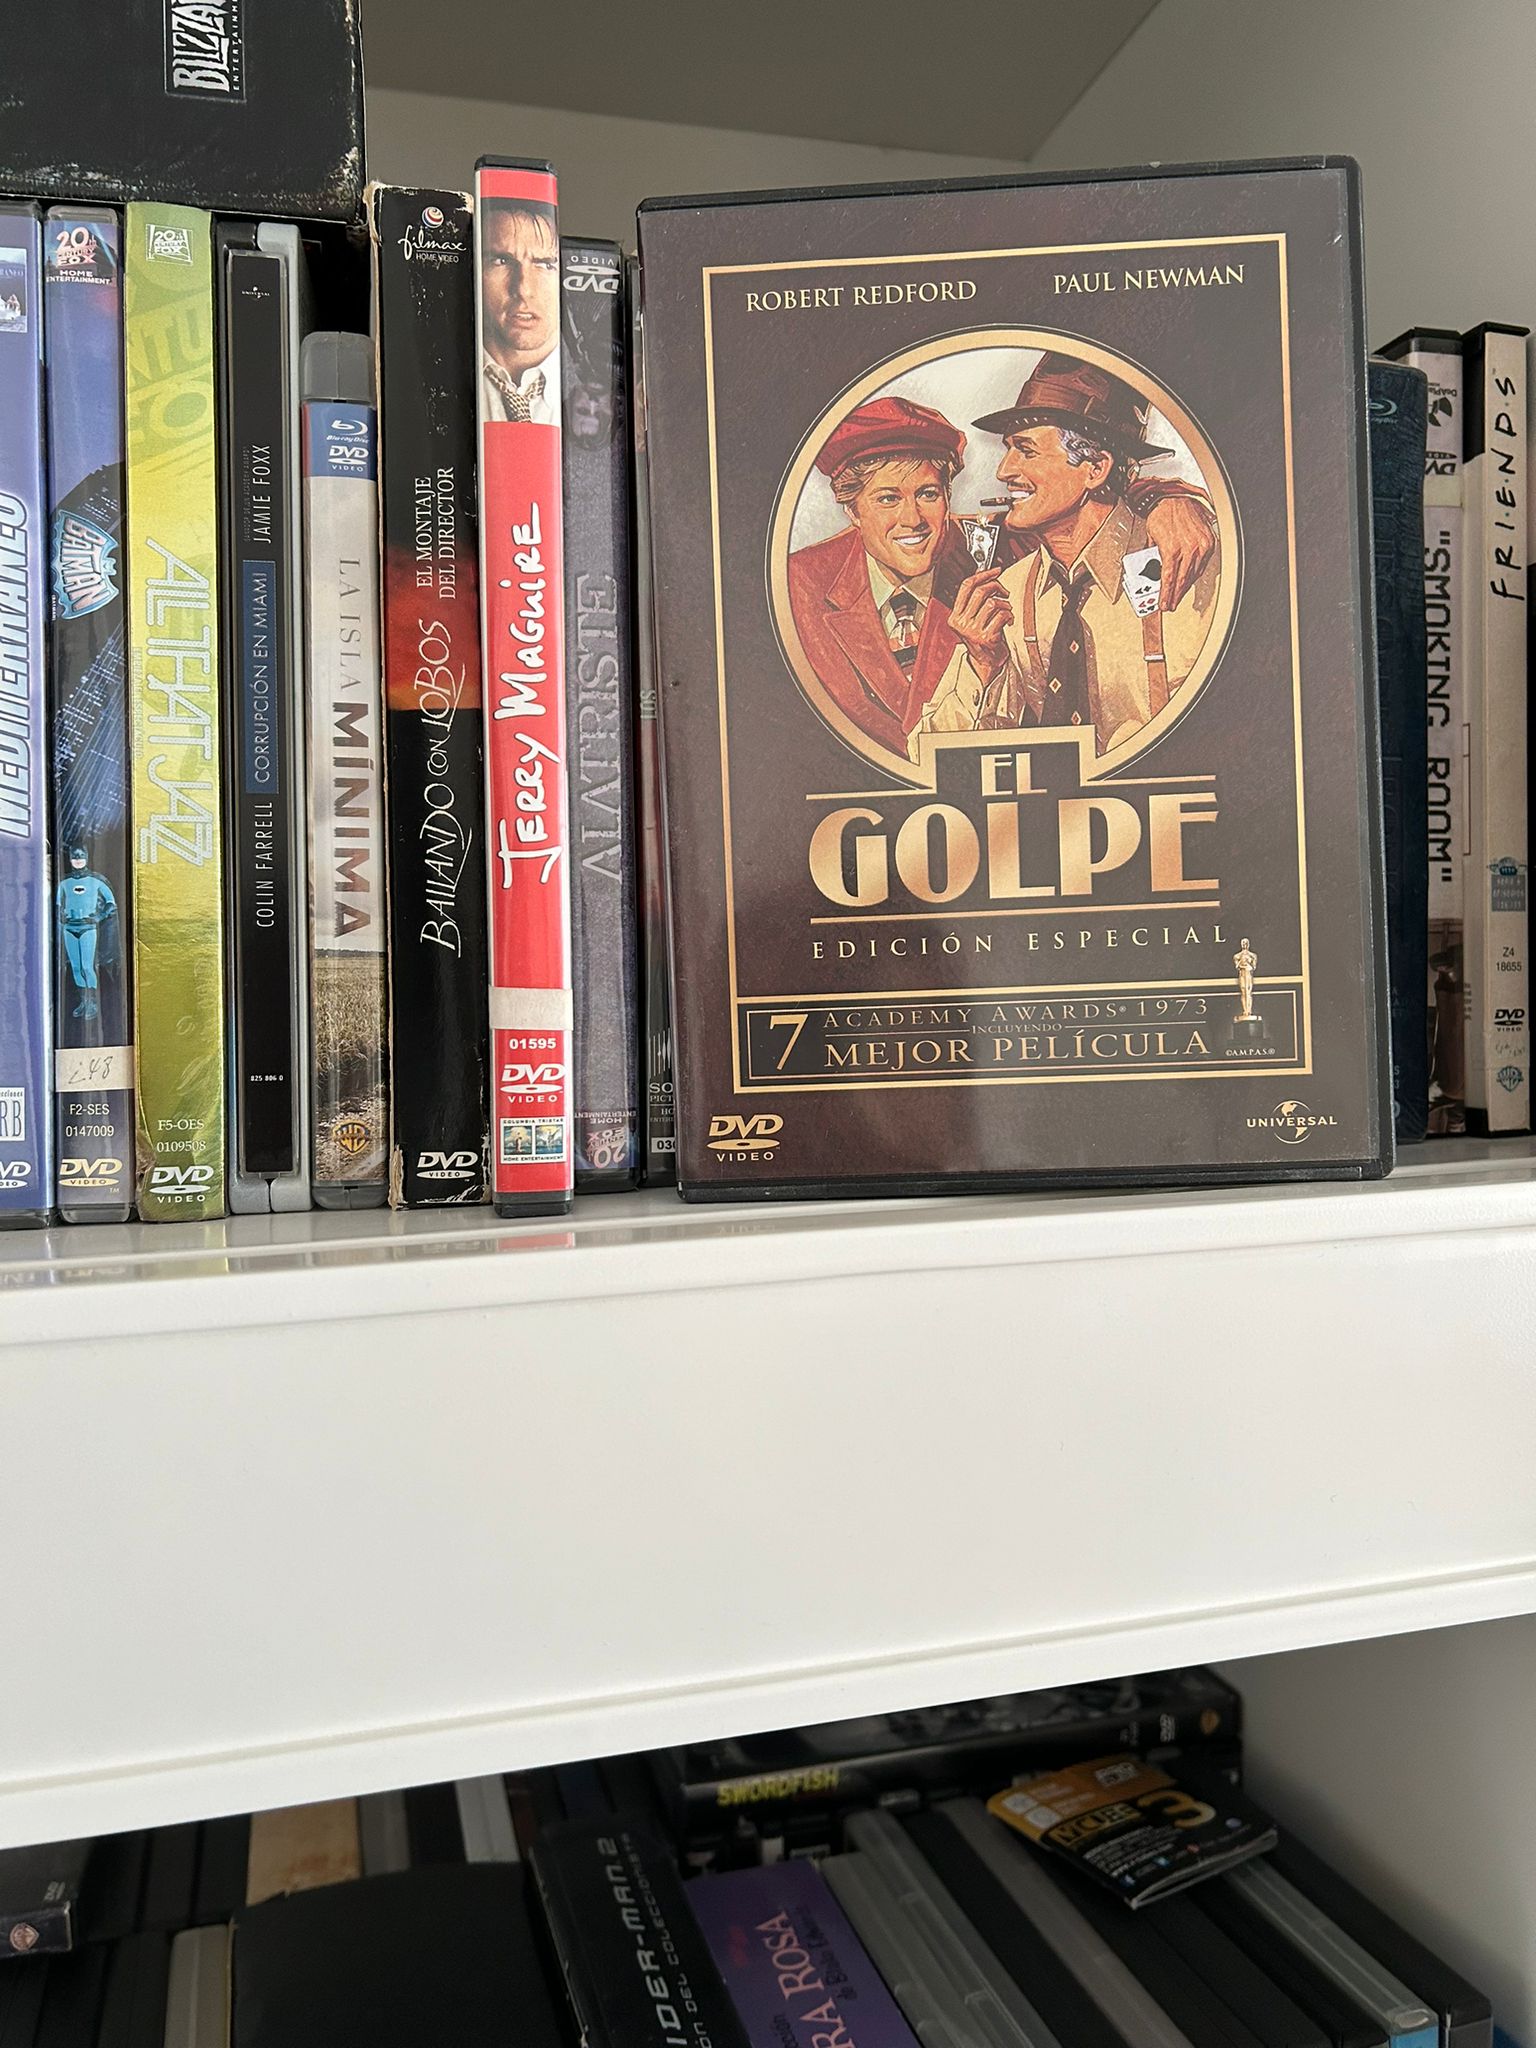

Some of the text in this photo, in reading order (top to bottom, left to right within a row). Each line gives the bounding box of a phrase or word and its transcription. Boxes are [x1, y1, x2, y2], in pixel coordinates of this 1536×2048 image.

[171, 0, 229, 92] BLIZZA
[232, 0, 241, 91] ENTERTAINM
[397, 225, 467, 261] filmax
[415, 253, 460, 263] HOME VIDEO
[570, 255, 615, 265] VIDEO
[46, 275, 111, 285] ENTERTAINMENT
[59, 269, 93, 278] HOME
[1053, 264, 1246, 295] PAUL NEWMAN
[241, 289, 271, 297] UNIVERSAL
[563, 274, 620, 295] DVD
[745, 280, 977, 313] ROBERT REDFORD
[329, 445, 369, 459] DVD
[331, 465, 364, 473] VIDEO
[1425, 461, 1457, 476] DV
[252, 445, 271, 544] JAMIE FOXX
[414, 476, 434, 588] EL MONTAJE
[437, 466, 457, 600] DEL DIRECTOR
[60, 517, 111, 611] BATMAN
[338, 557, 362, 693] LA ISLA
[251, 571, 271, 784] CORRUPCIÓN EN MIAMI
[146, 625, 213, 761] THAT
[575, 573, 623, 885] ALATRISTE
[980, 752, 1048, 797] EL
[332, 702, 374, 938] MÍNIMA
[808, 791, 1220, 907] GOLPE
[255, 801, 275, 928] COLIN FARRELL
[812, 924, 1227, 960] EDICIÓN ESPECIAL
[1502, 946, 1515, 957] Z4
[823, 1008, 972, 1029] ACADEMY
[1137, 998, 1208, 1017] 1973
[1494, 1008, 1525, 1021] DVD
[971, 1022, 1063, 1036] INCLUYENDO
[509, 1037, 557, 1050] 01595
[769, 1013, 809, 1071] 7
[823, 1028, 1212, 1071] MEJOR PELÍCULA
[501, 1063, 566, 1083] DVD
[507, 1094, 559, 1103] VIDEO
[69, 1103, 110, 1116] F2-SES
[157, 1119, 205, 1132] F5-OES
[590, 1117, 622, 1125] HOME
[708, 1113, 784, 1139] DVD
[1246, 1115, 1338, 1129] UNIVERSAL
[65, 1125, 115, 1138] 0147009
[156, 1140, 207, 1153] 0109508
[657, 1139, 676, 1150] 03
[416, 1151, 478, 1169] DVD
[716, 1151, 774, 1163] VIDEO
[59, 1158, 123, 1179] DVD
[150, 1165, 215, 1185] DVD
[69, 1178, 108, 1186] VIDEO
[157, 1194, 206, 1204] VIDEO
[716, 1768, 840, 1808] SWORDFISH
[755, 1910, 825, 2000] ROSA
